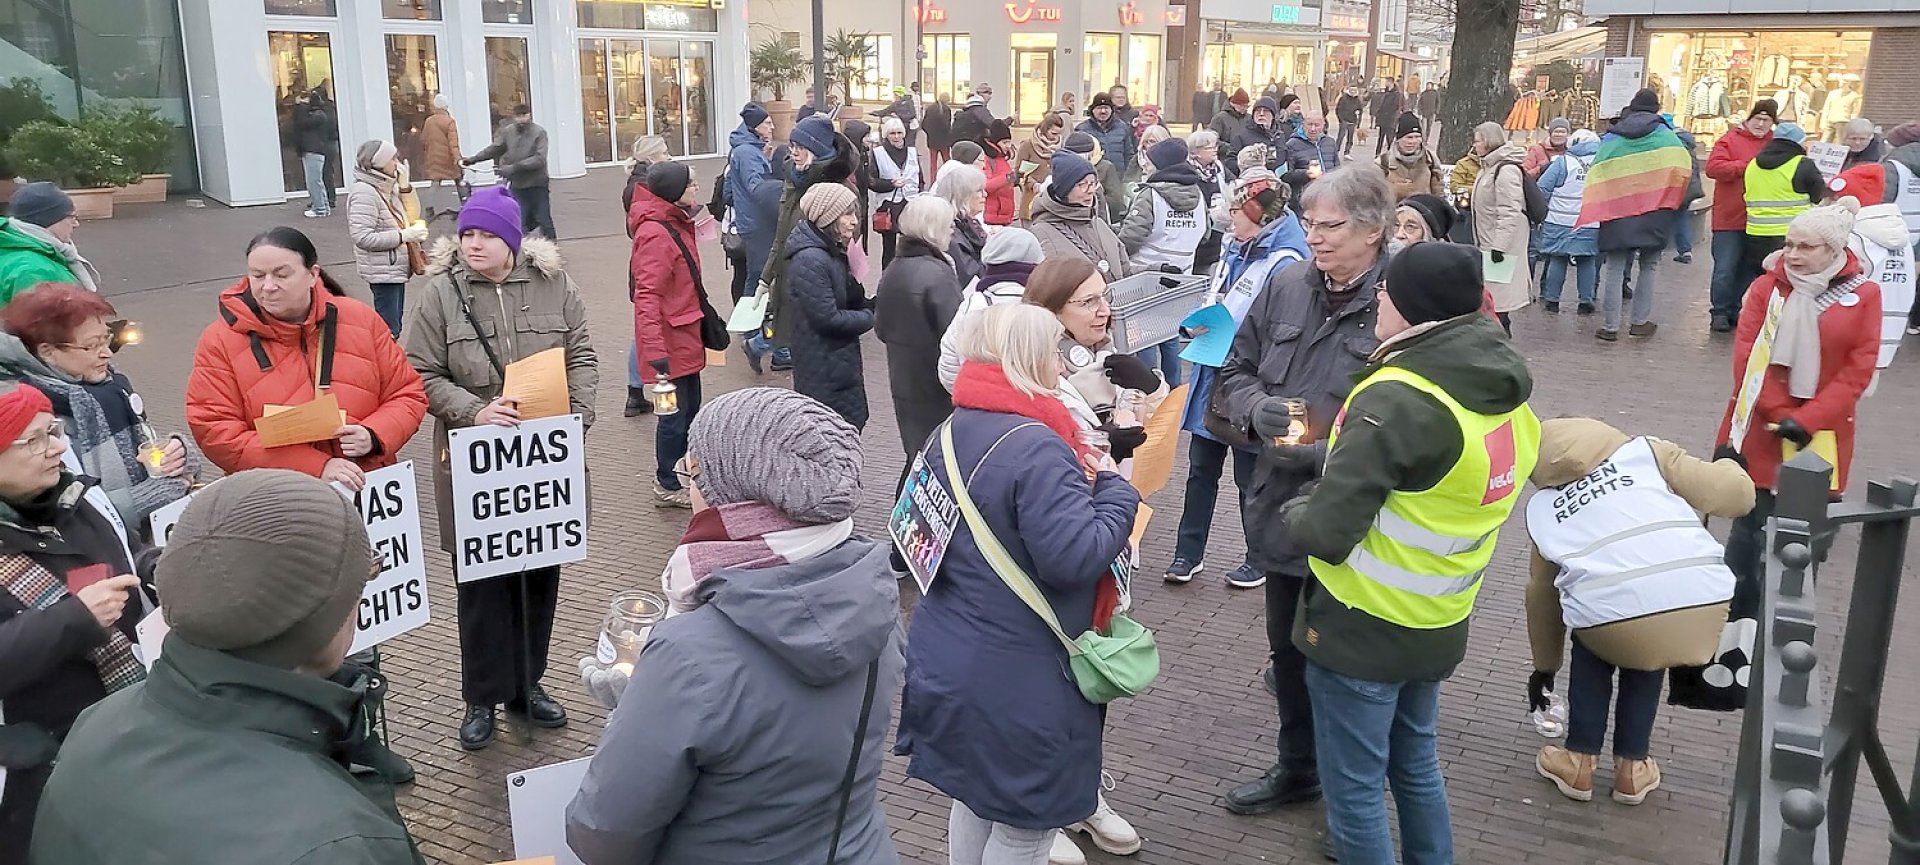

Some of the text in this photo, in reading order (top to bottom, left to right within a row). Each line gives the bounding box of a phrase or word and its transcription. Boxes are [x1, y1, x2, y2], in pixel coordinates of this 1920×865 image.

[930, 9, 944, 20] TUI
[1038, 8, 1061, 20] TUI
[1165, 220, 1197, 228] RECHTS
[1167, 210, 1193, 218] GEGEN
[469, 429, 569, 474] OMAS
[354, 480, 403, 525] AS
[472, 478, 571, 520] GEGEN
[1553, 463, 1618, 509] GEGEN
[1555, 475, 1634, 523] RECHTS
[464, 520, 582, 566] RECHTS
[356, 579, 421, 631] CHTS
